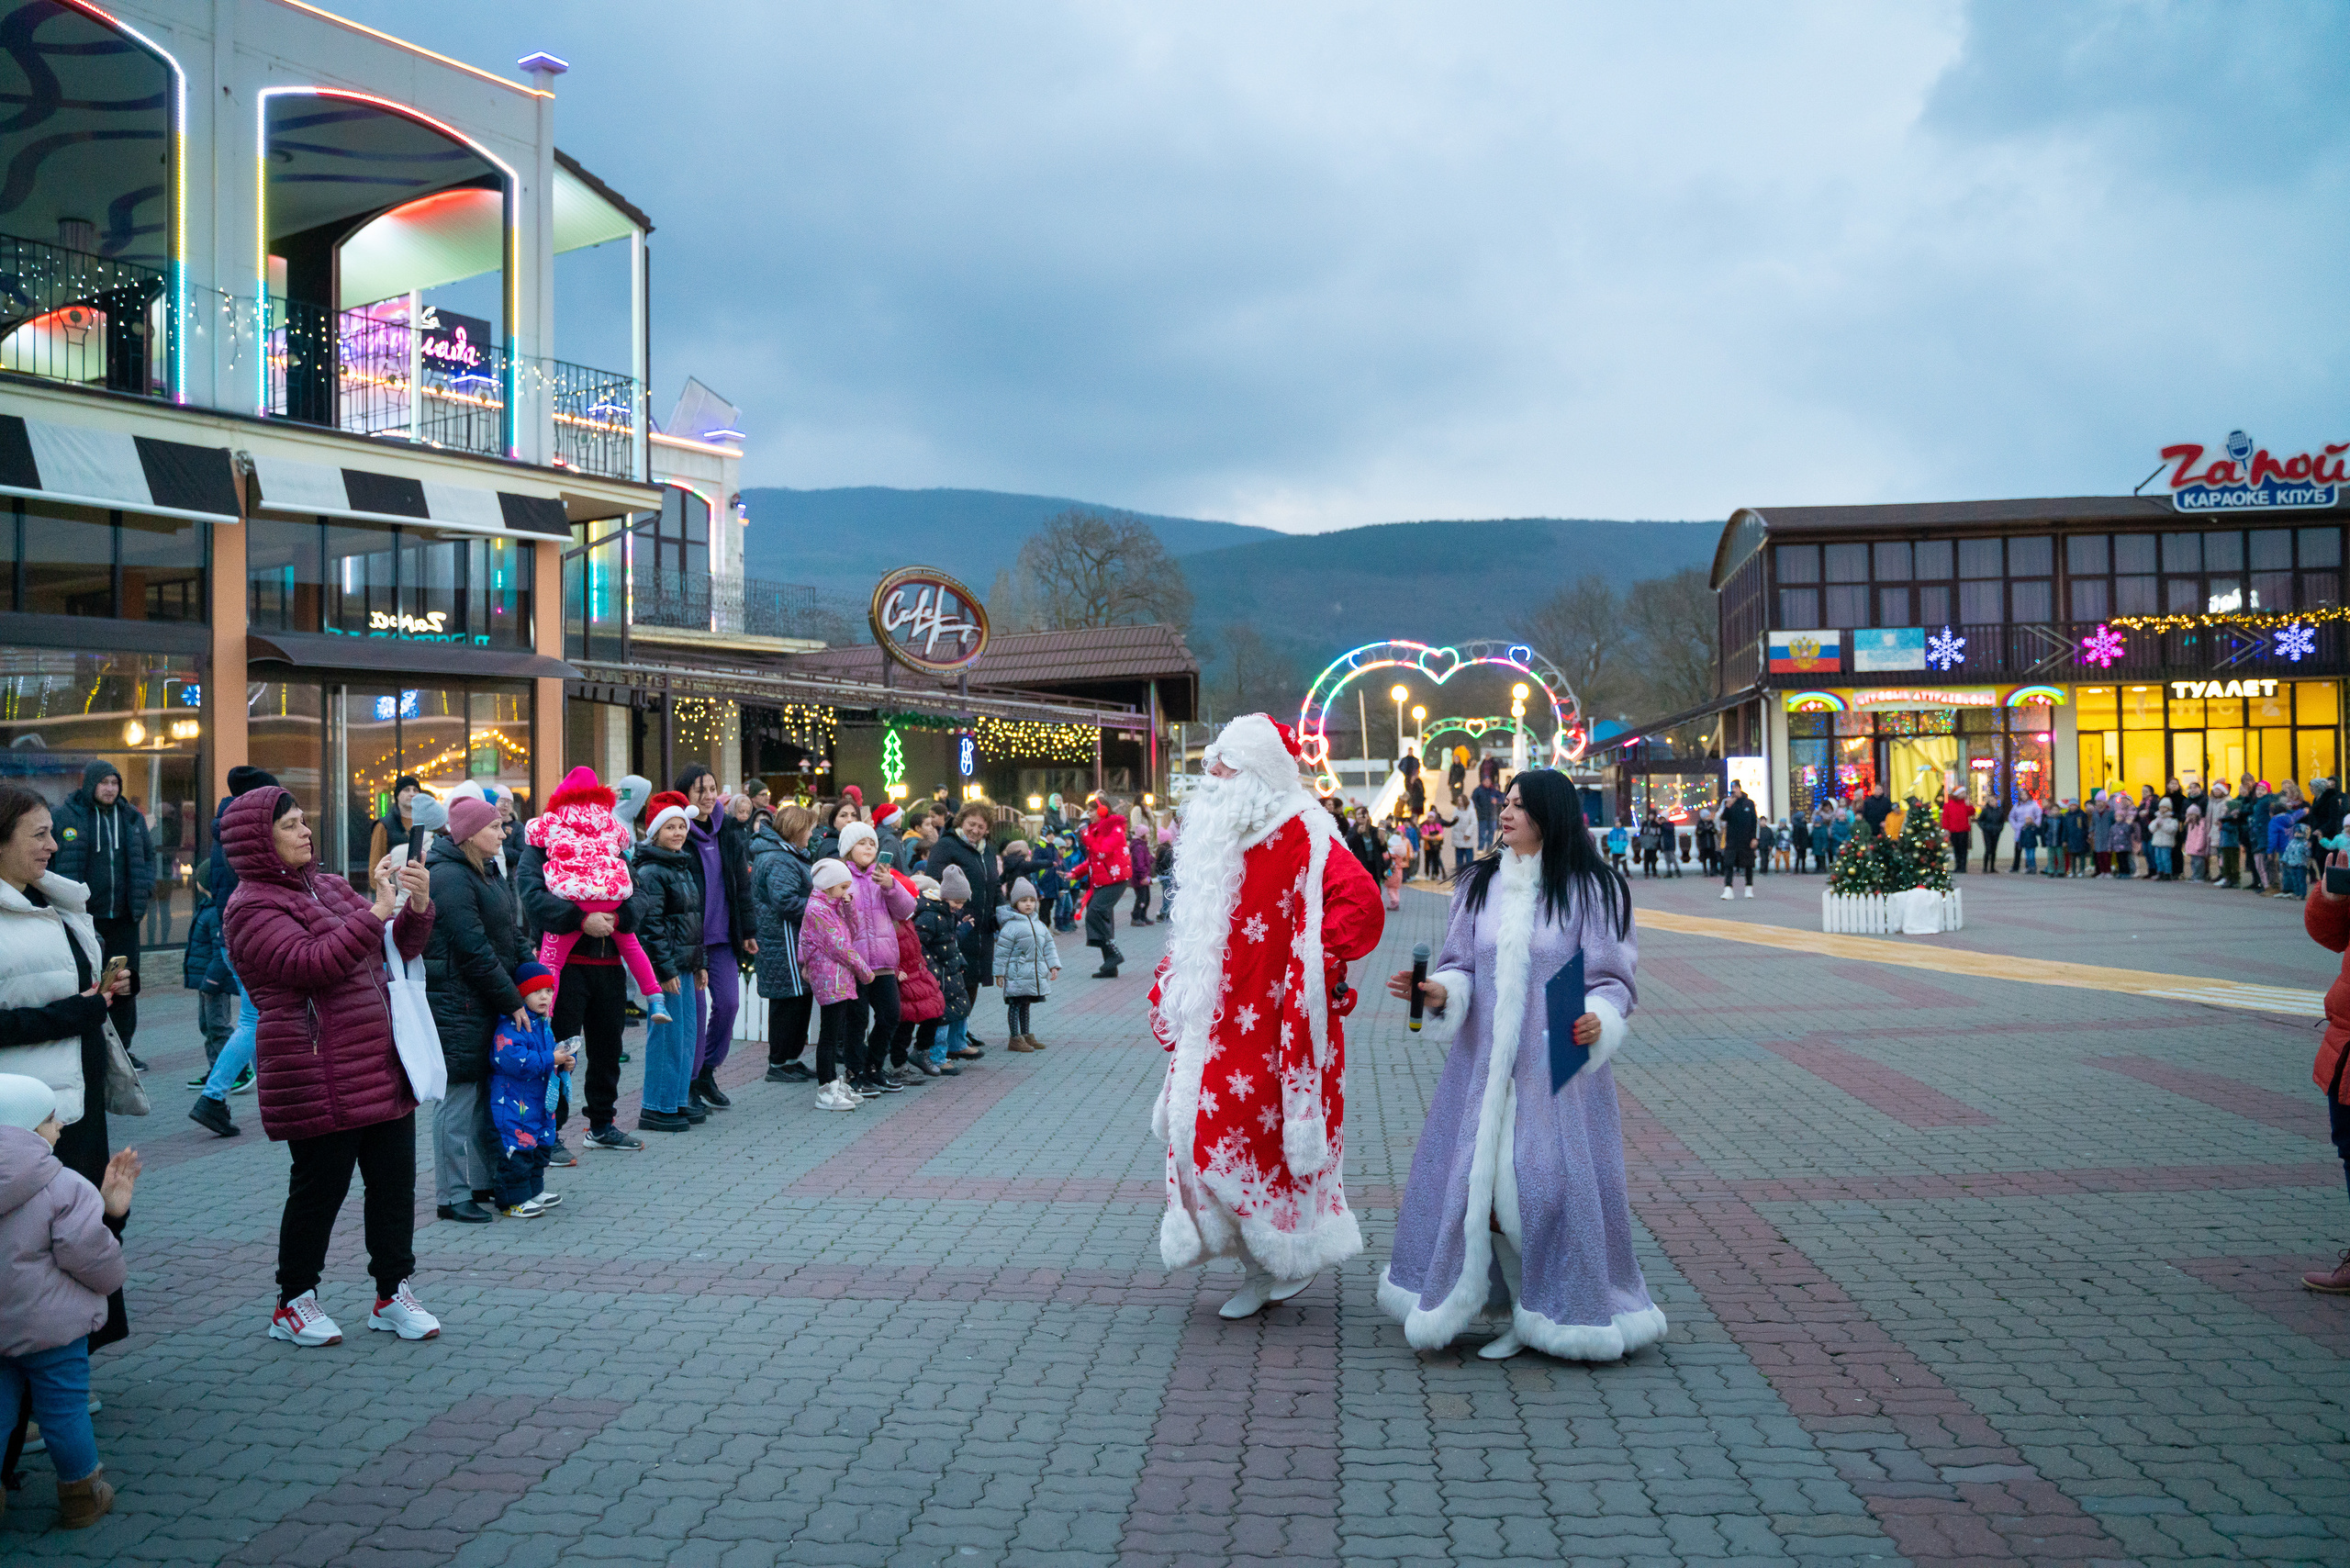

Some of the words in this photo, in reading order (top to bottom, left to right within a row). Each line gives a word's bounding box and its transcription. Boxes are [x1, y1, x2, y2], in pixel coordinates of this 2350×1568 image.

[2184, 490, 2269, 507] КАРАОКЕ
[2277, 488, 2327, 504] КЛУБ
[2171, 678, 2278, 699] ТУАЛЕТ
